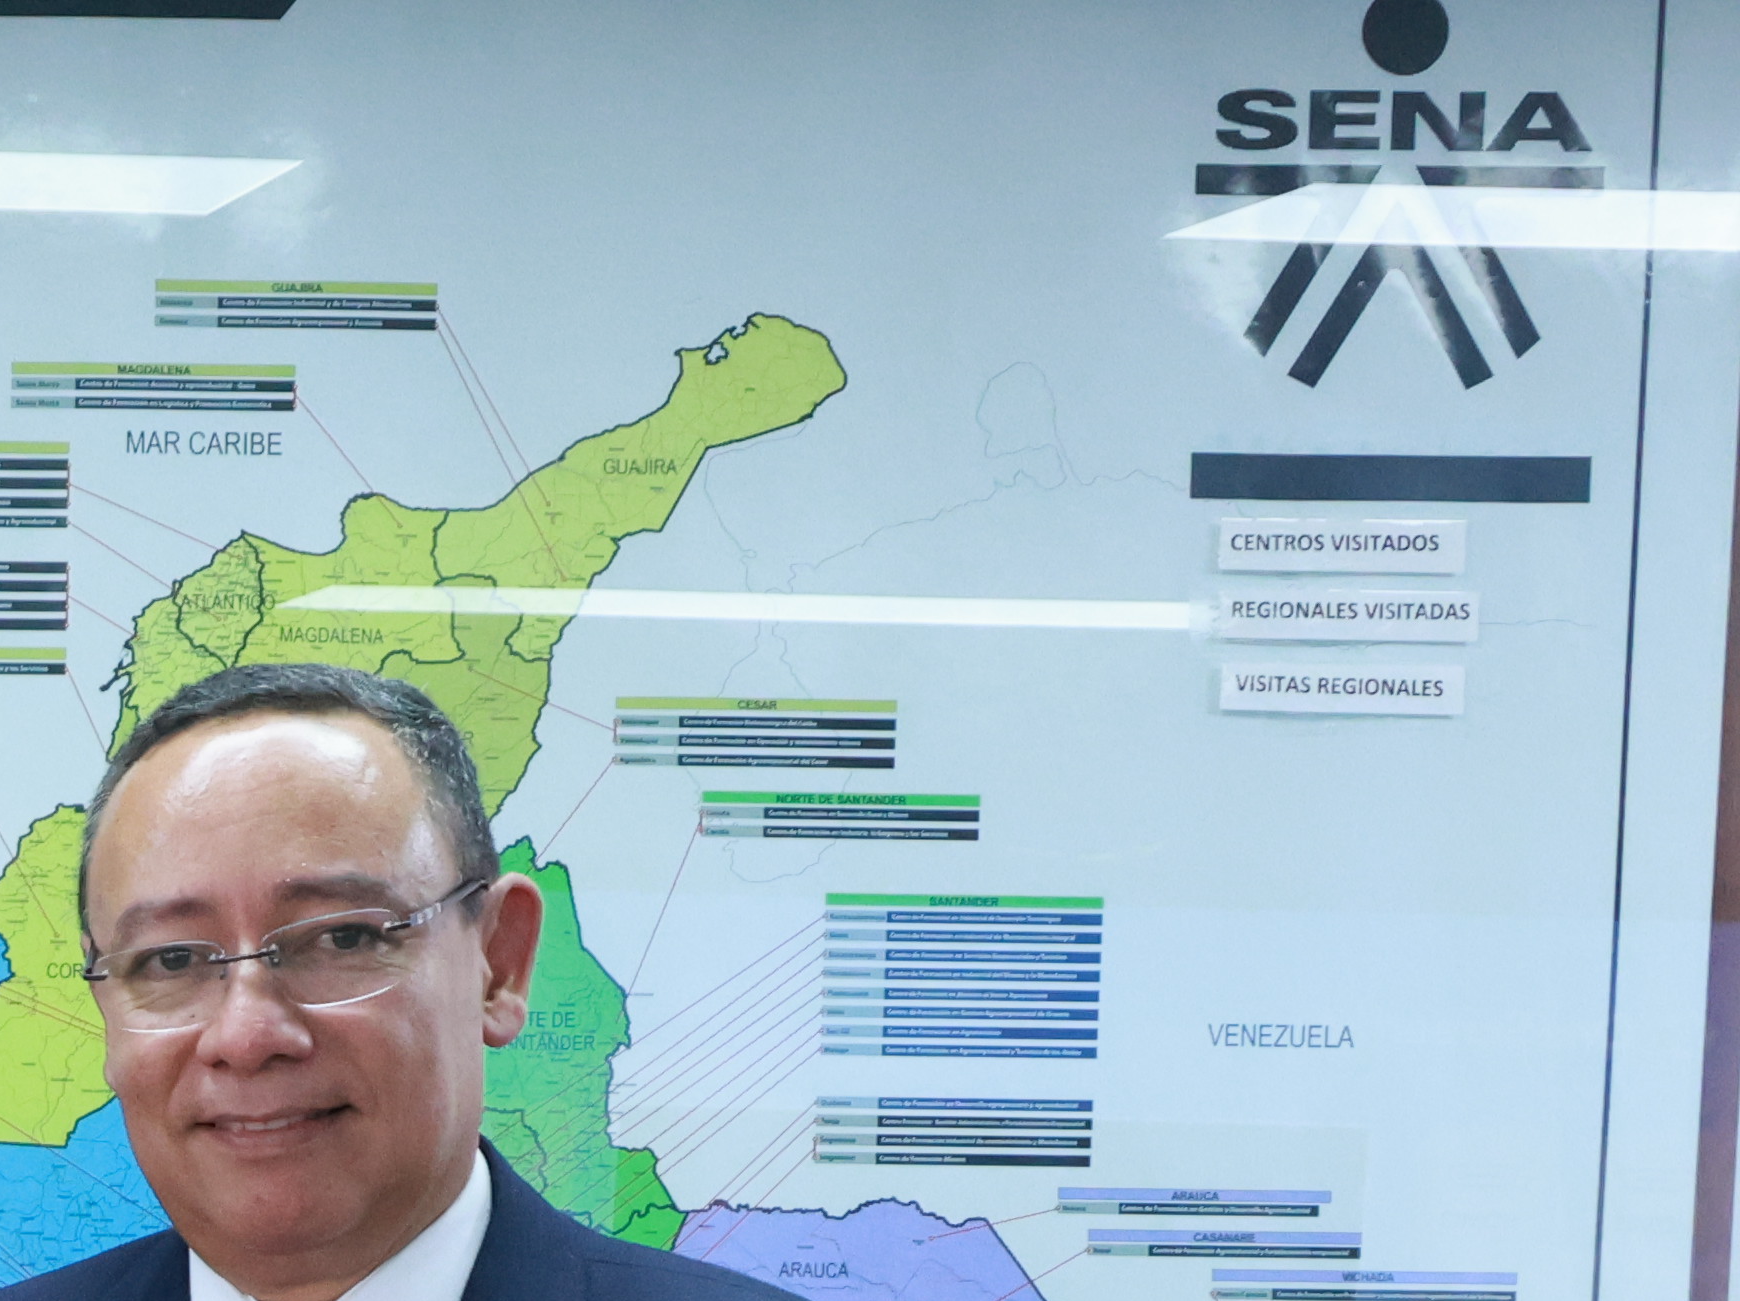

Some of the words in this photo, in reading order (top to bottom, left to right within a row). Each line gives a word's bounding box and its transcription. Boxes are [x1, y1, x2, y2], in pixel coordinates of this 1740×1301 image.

[1216, 89, 1592, 151] SENA
[117, 365, 191, 375] MAGDALENA
[126, 431, 180, 454] MAR
[189, 433, 282, 455] CARIBE
[603, 459, 677, 474] GUAJIRA
[1230, 534, 1324, 551] CENTROS
[1331, 535, 1439, 552] VISITADOS
[1231, 602, 1357, 620] REGIONALES
[1365, 602, 1470, 620] VISITADAS
[281, 627, 383, 644] MAGDALENA
[1236, 675, 1310, 694] VISITAS
[1318, 677, 1443, 696] REGIONALES
[737, 700, 776, 710] CESAR
[777, 794, 814, 803] NORTE
[819, 795, 833, 804] DE
[838, 795, 906, 804] SANTANDER
[929, 897, 998, 906] SANTANDER
[1208, 1023, 1354, 1049] VENEZUELA
[1172, 1191, 1219, 1201] ARAUCA
[1193, 1232, 1255, 1243] CASANARE
[779, 1262, 848, 1278] ARAUCA
